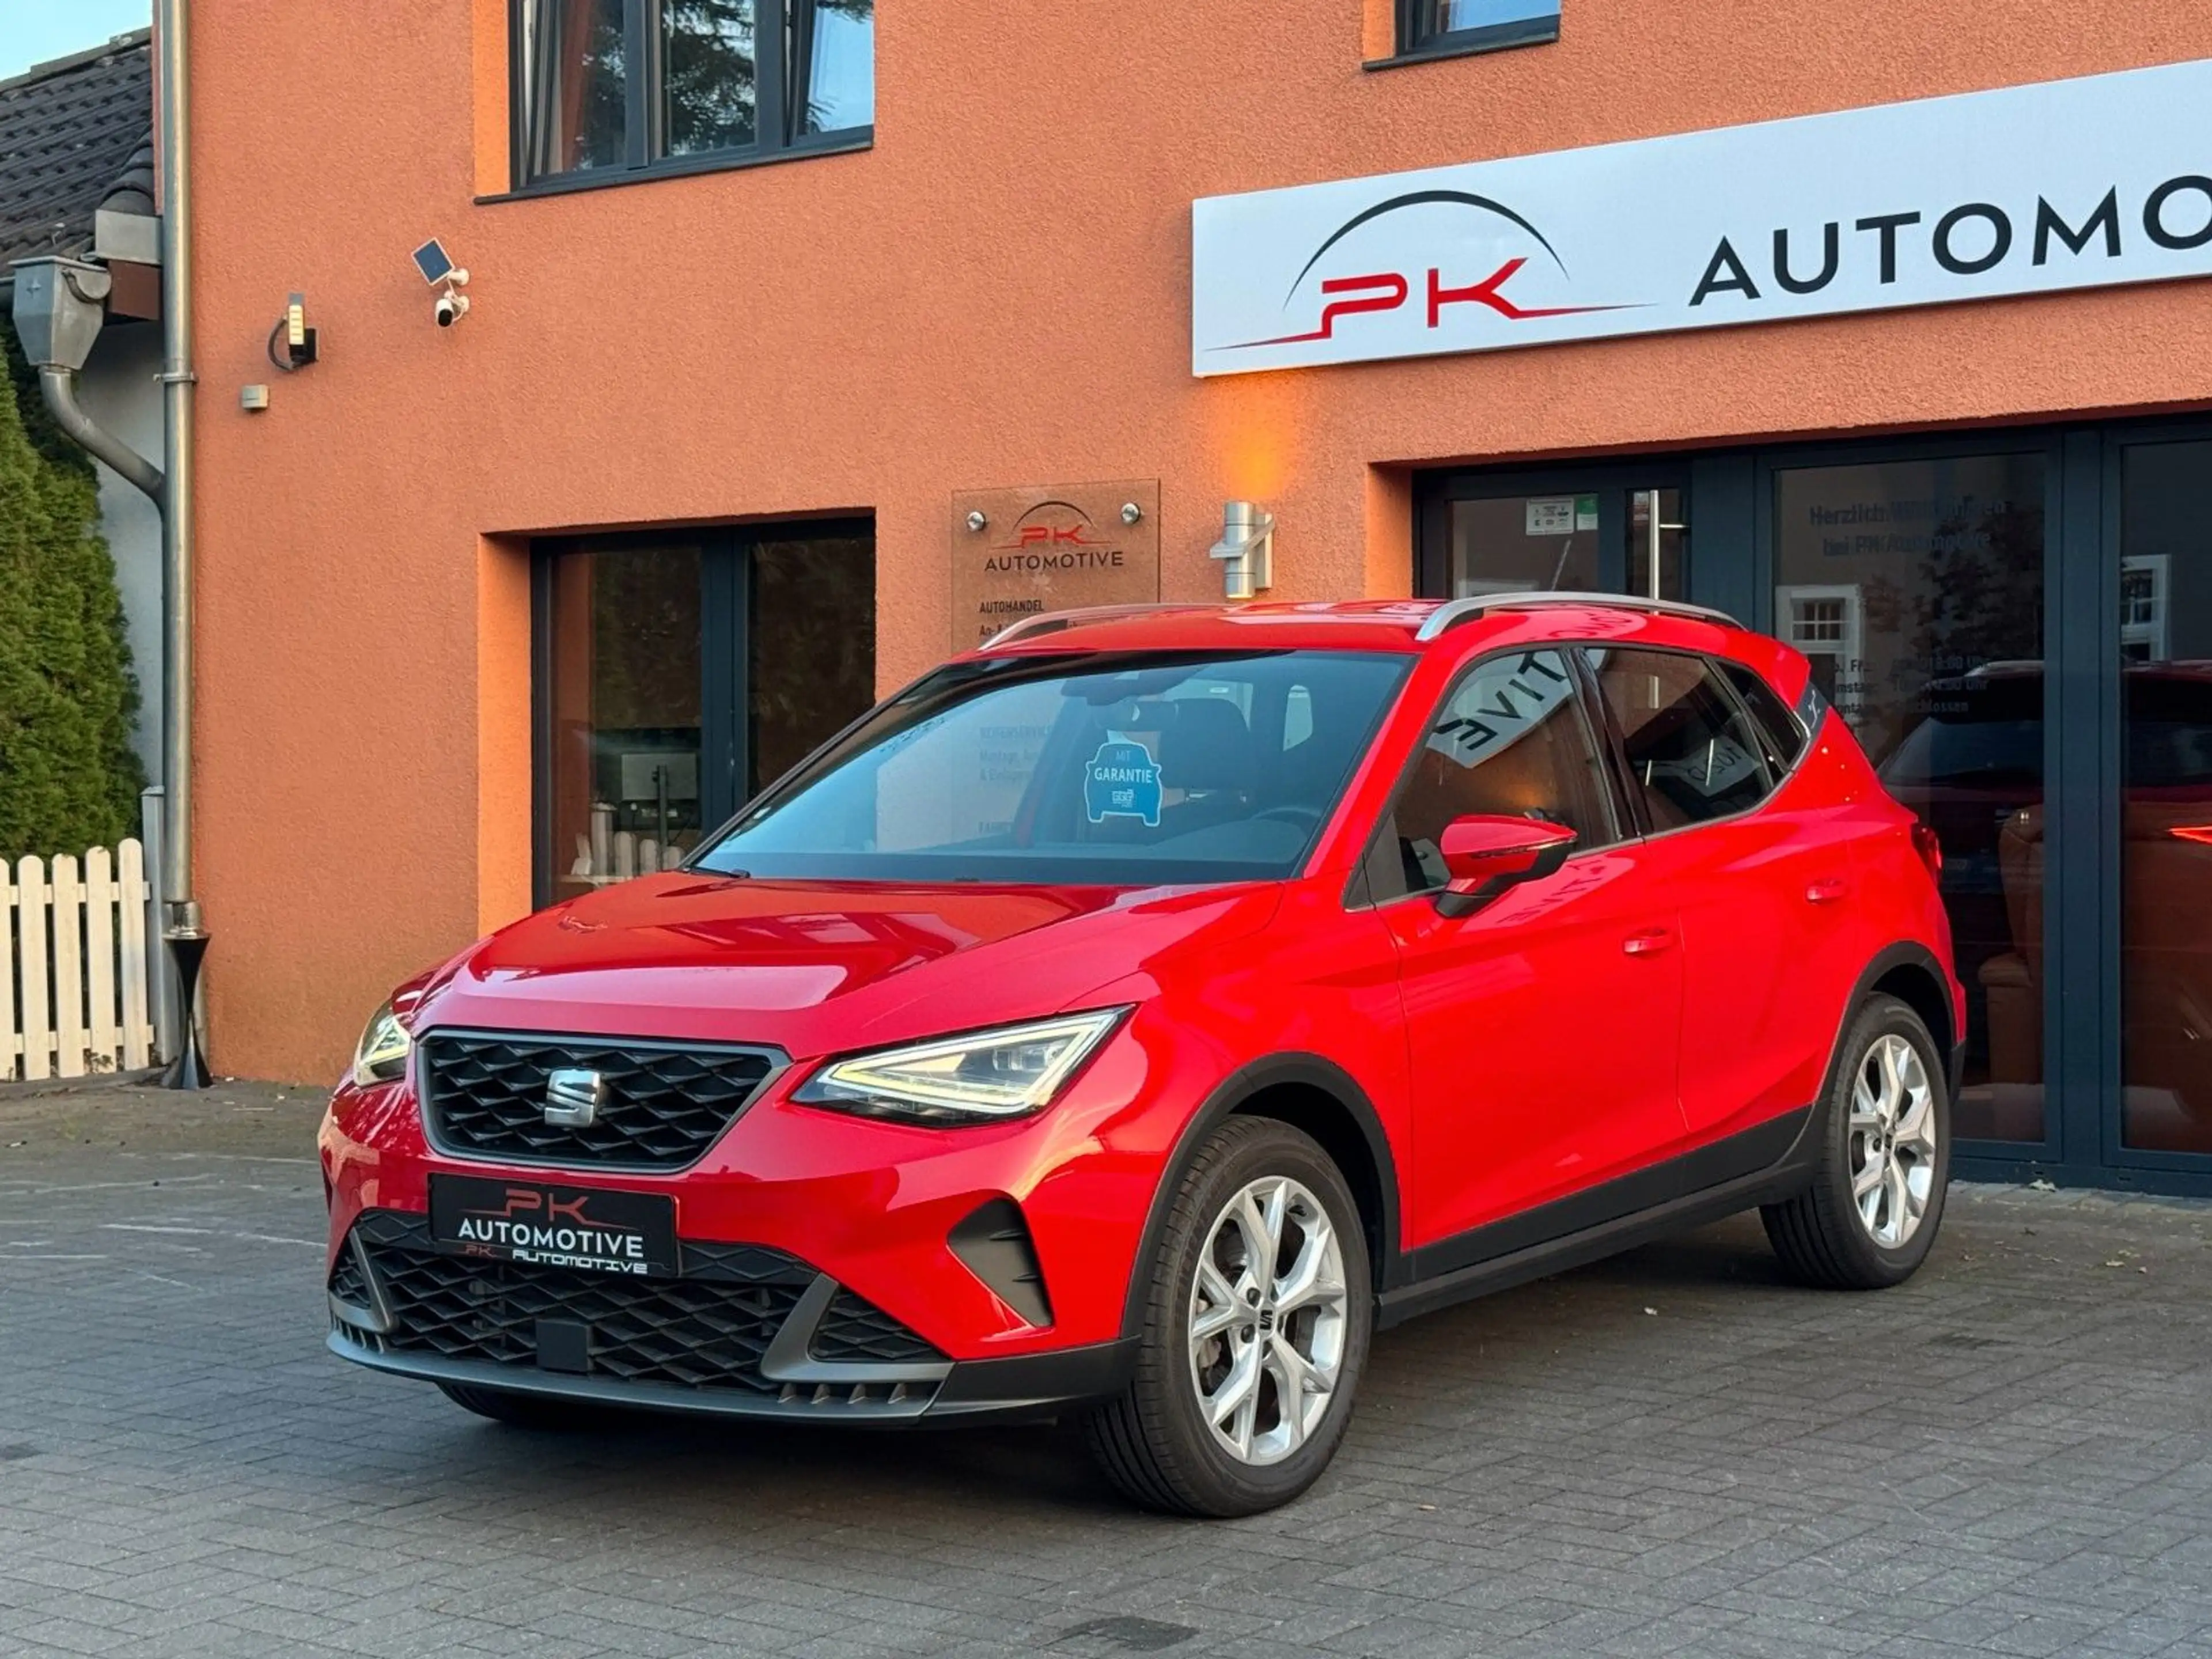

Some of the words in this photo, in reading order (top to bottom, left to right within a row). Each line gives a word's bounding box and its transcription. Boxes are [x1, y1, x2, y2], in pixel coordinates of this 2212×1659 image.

[1320, 256, 1530, 340] PK
[1688, 173, 2212, 306] AUTOMO
[984, 551, 1124, 571] AUTOMOTIVE
[979, 599, 1045, 614] AUTOHANDEL
[1094, 767, 1153, 784] GARANTIE
[459, 1217, 644, 1258] AUTOMOTIVE
[512, 1249, 648, 1274] AUTOMOTIVE
